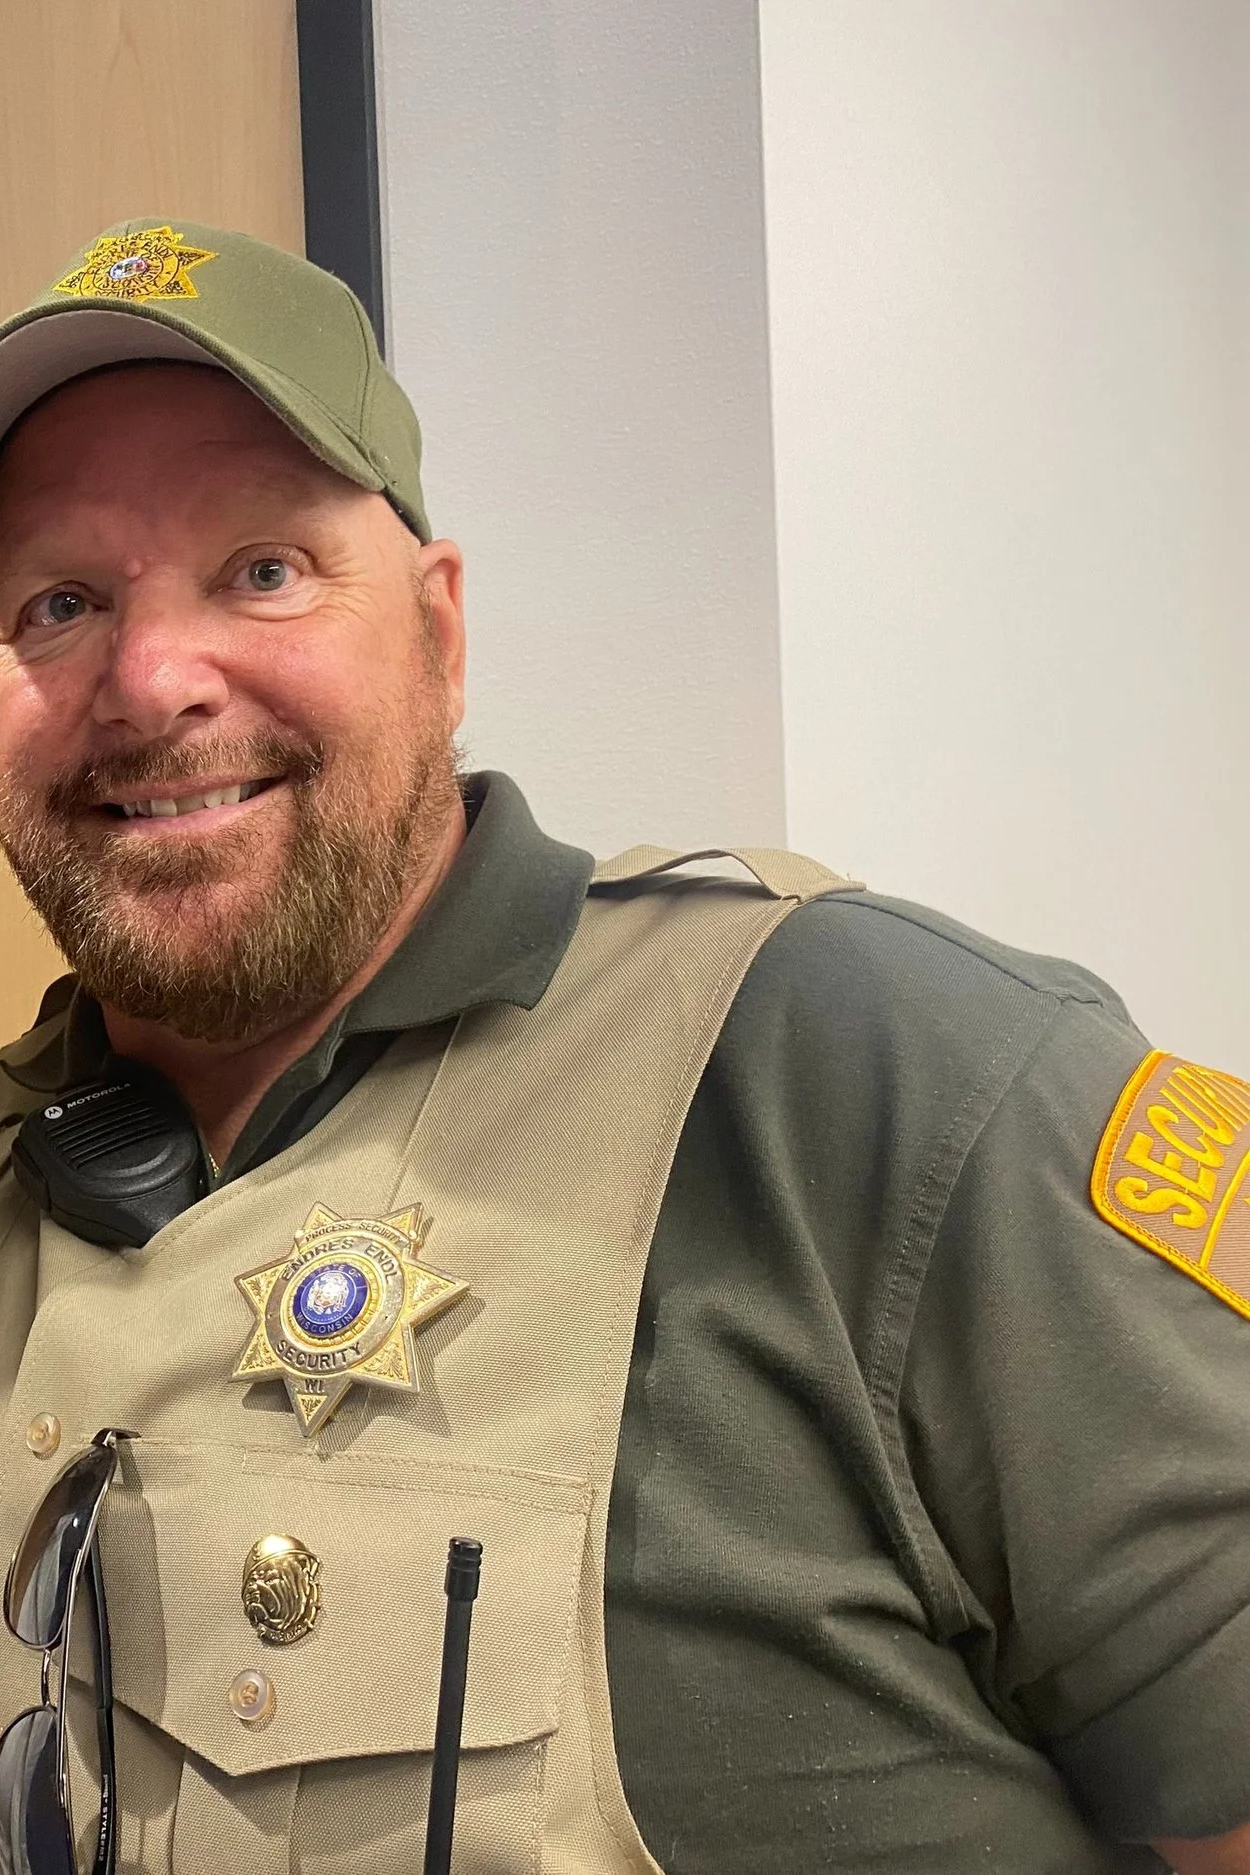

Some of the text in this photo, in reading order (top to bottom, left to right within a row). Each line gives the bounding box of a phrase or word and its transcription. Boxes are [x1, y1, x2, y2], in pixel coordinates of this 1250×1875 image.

[67, 1083, 131, 1108] MOTOROLA
[305, 1223, 351, 1242] PROCESS
[281, 1239, 398, 1284] ENDRES ENDL
[348, 1268, 362, 1279] OF
[296, 1311, 354, 1334] WISCONSIN
[276, 1339, 361, 1371] SECURITY
